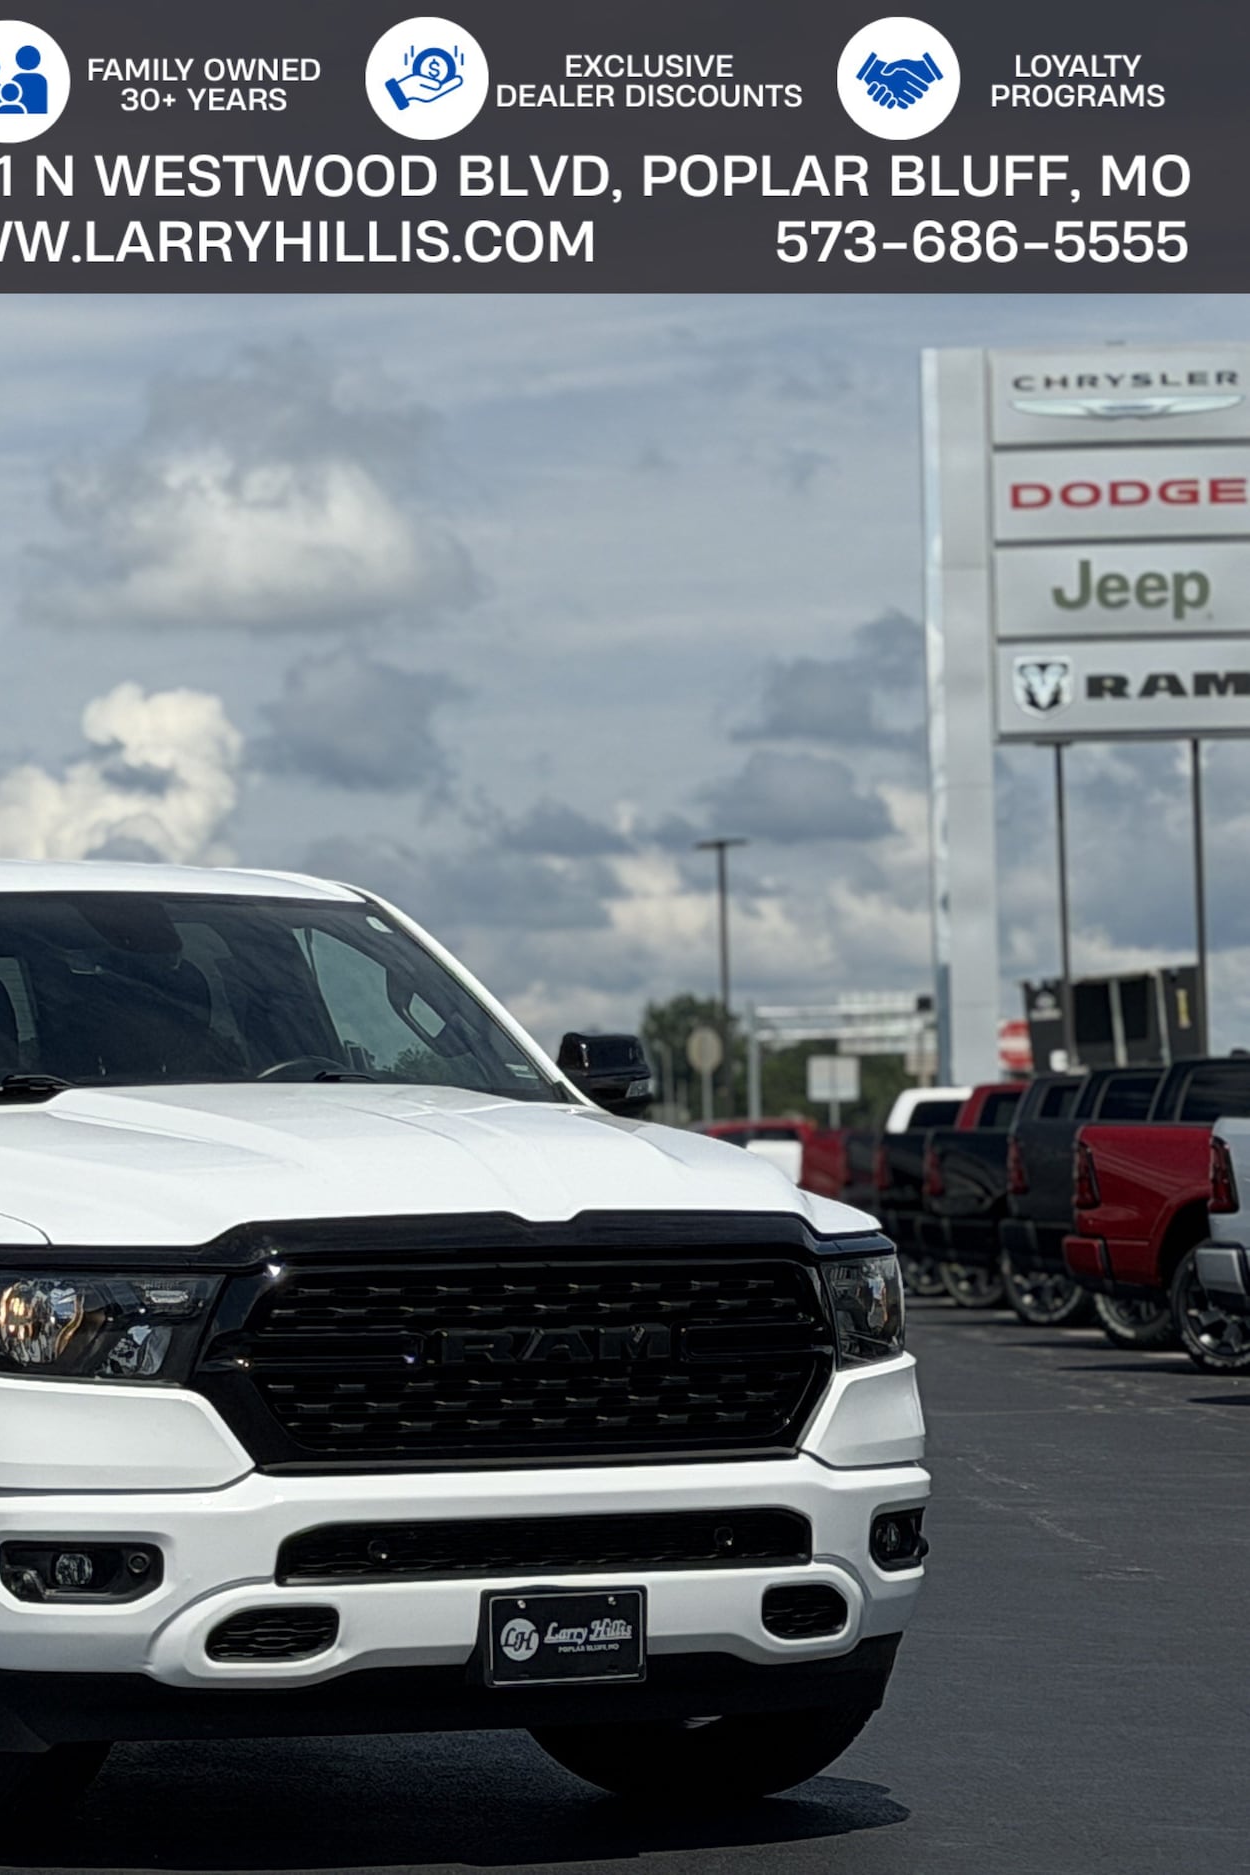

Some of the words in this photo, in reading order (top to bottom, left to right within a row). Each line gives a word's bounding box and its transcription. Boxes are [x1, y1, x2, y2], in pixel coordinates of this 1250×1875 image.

[1012, 370, 1240, 391] CHRYSLER
[1010, 478, 1248, 509] DODGE
[1052, 559, 1211, 621] Jeep
[1086, 671, 1250, 699] RAM
[440, 1325, 671, 1363] RAM
[544, 1621, 588, 1645] Larry
[590, 1617, 633, 1640] Hillis
